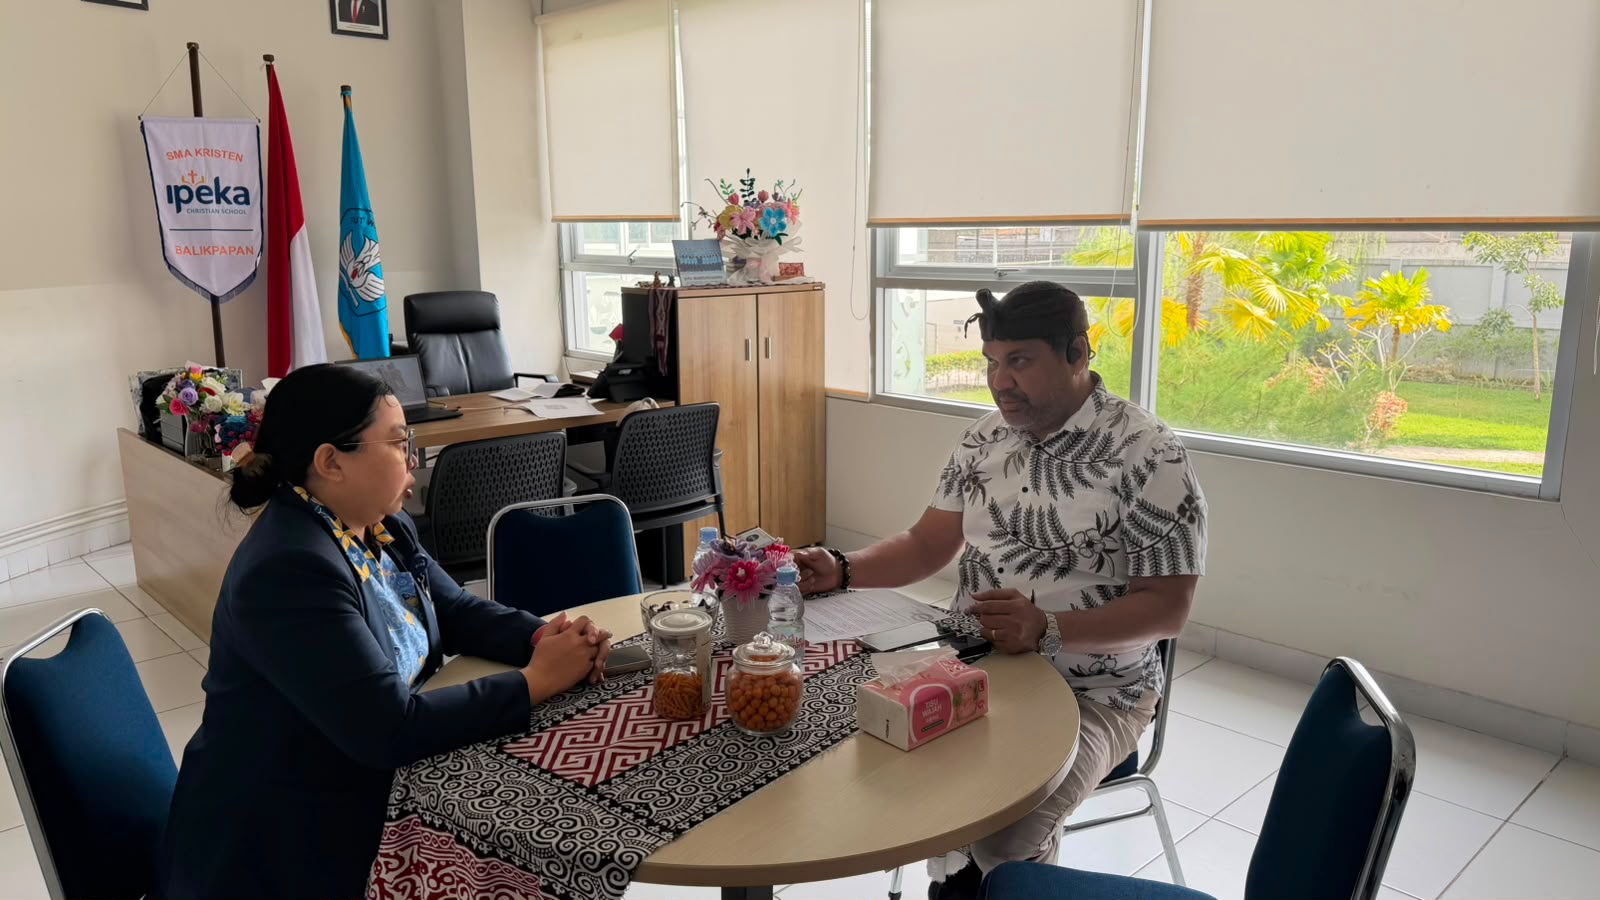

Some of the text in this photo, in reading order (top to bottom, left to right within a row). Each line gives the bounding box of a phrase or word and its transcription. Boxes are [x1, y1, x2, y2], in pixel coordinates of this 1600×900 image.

[166, 147, 244, 162] SMA KRISTEN
[175, 245, 256, 257] BALIKPAPAN
